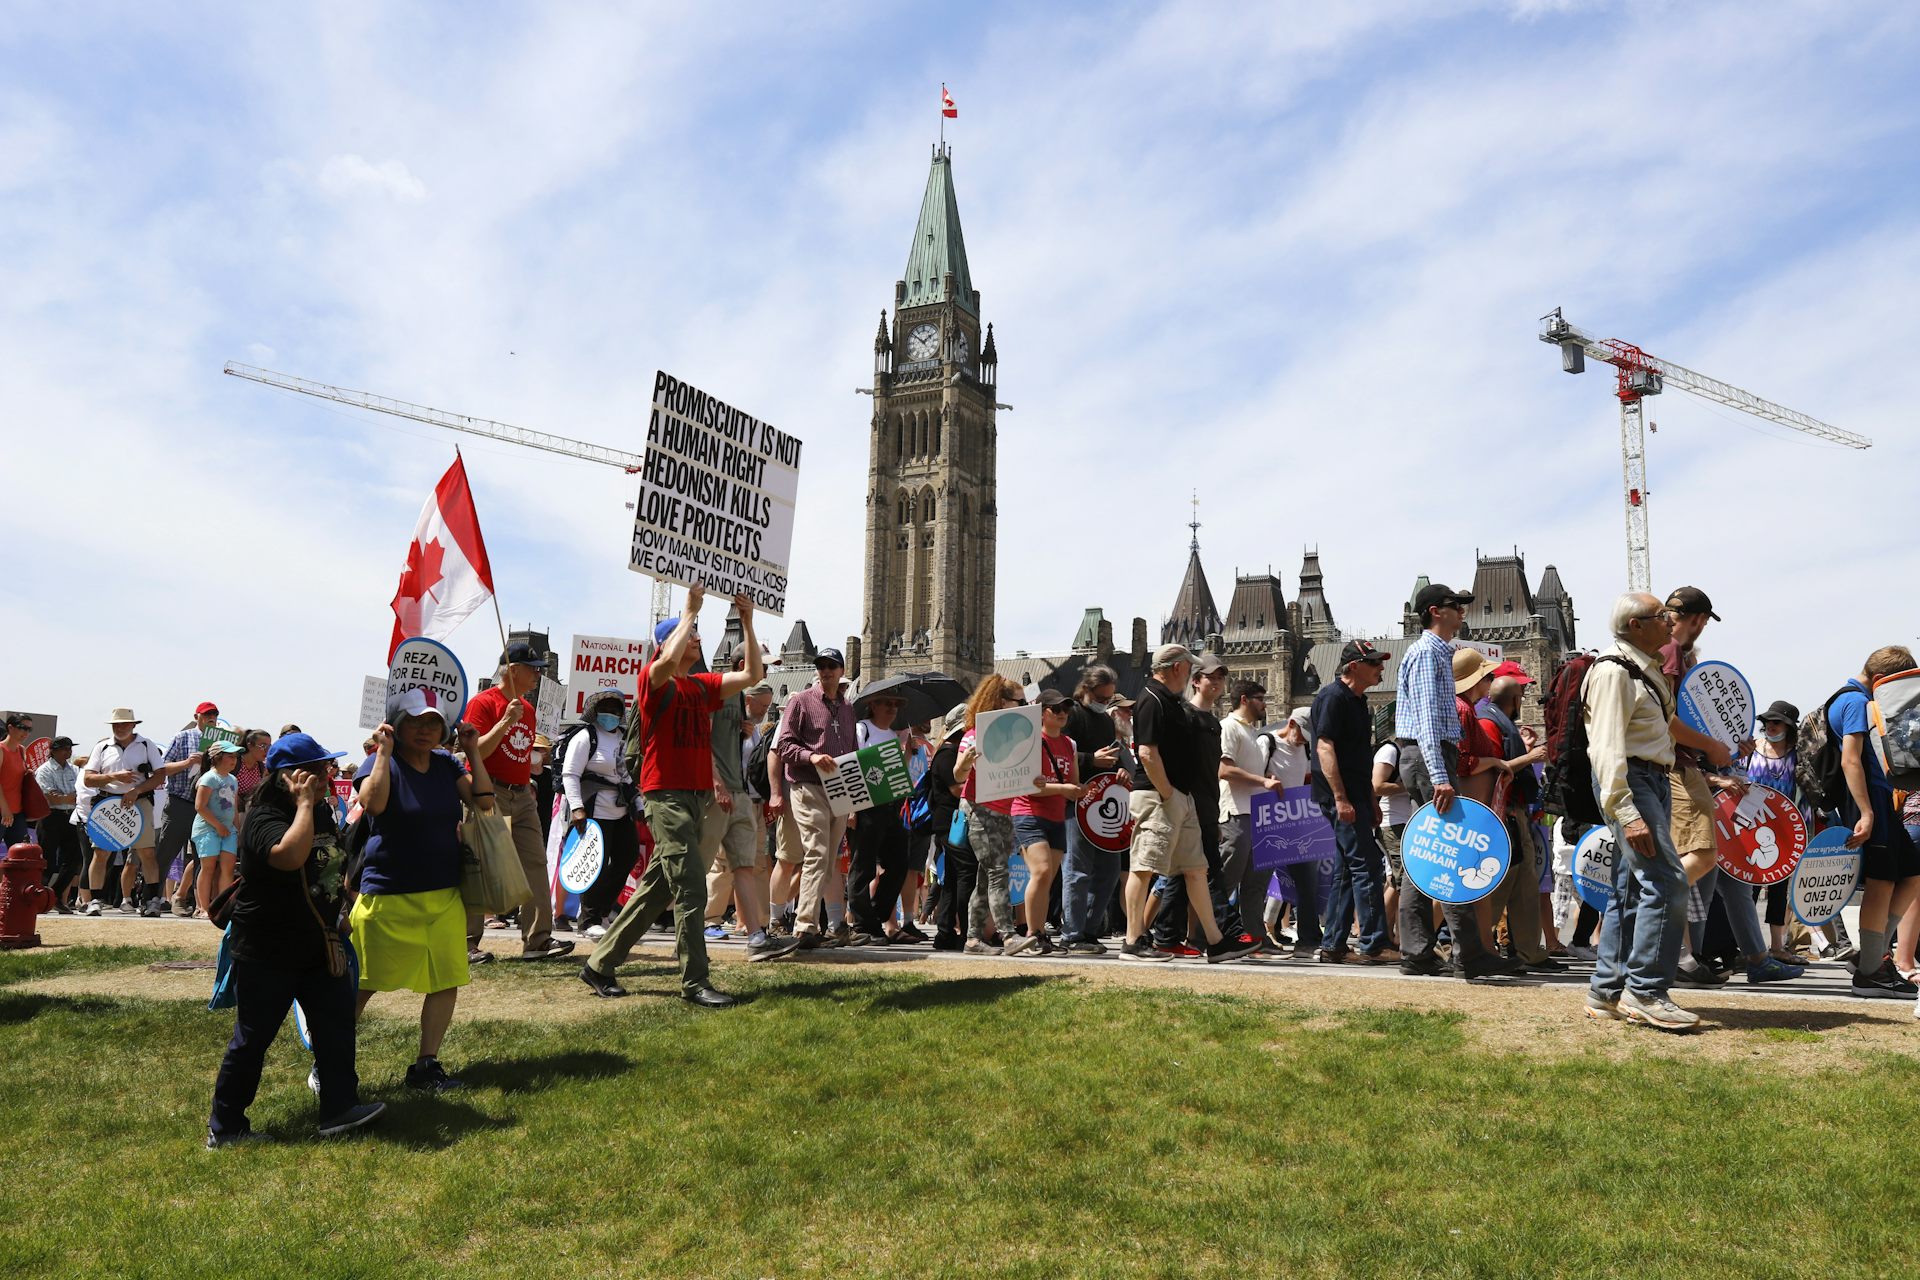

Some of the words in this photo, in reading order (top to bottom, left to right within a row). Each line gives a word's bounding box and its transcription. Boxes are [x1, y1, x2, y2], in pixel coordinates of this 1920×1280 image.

[653, 370, 758, 447] PROMISCUITY
[760, 422, 774, 456] IS
[776, 432, 802, 469] NOT
[647, 409, 658, 444] A
[662, 414, 720, 470] HUMAN
[722, 443, 766, 488] RIGHT
[642, 447, 728, 512] HEDONISM
[730, 486, 770, 528] KILLS
[636, 486, 682, 532] LOVE
[682, 501, 762, 562] PROTECTS
[633, 524, 667, 550] HOW
[669, 538, 710, 565] MANLY
[712, 552, 722, 571] IS
[724, 554, 734, 573] IT
[734, 559, 746, 578] TO
[746, 565, 762, 585] KILL
[763, 570, 787, 593] KIDS?
[632, 546, 653, 569] WE
[656, 555, 695, 582] CAN'T
[698, 570, 741, 596] HANDLE
[744, 584, 755, 603] THE
[756, 589, 785, 612] CHOICE
[581, 640, 623, 652] NATIONAL
[404, 652, 438, 666] REZA
[576, 654, 642, 675] MARCH
[393, 667, 407, 680] POR
[411, 668, 427, 680] EL
[432, 671, 457, 686] FIN
[598, 679, 618, 687] FOR
[1699, 671, 1714, 696] DEL
[1712, 697, 1740, 744] ABORTO
[1711, 671, 1728, 697] POR
[1725, 698, 1736, 714] EL
[1734, 714, 1748, 734] FIN
[1728, 680, 1746, 712] REZA
[203, 727, 223, 741] LOVE
[501, 744, 517, 760] GUARD
[878, 742, 903, 772] LOVE
[840, 760, 870, 805] CHOOSE
[887, 772, 912, 797] LIFE
[988, 767, 1030, 781] WOOMB
[1004, 779, 1022, 789] LIFE
[824, 776, 846, 800] LIFE
[99, 808, 135, 838] ABORTION
[111, 804, 121, 814] TO
[120, 813, 136, 827] END
[1256, 804, 1271, 827] JE
[1274, 798, 1323, 823] SUIS
[1417, 816, 1441, 835] JE
[1442, 823, 1490, 852] SUIS
[1716, 820, 1731, 840] I
[1762, 801, 1804, 882] WONDERFULLY
[567, 834, 598, 881] ABORTION
[590, 849, 599, 863] TO
[1413, 834, 1431, 848] UN
[1431, 838, 1459, 857] ÊTRE
[1409, 846, 1457, 870] HUMAIN
[1717, 854, 1753, 880] MADE
[576, 864, 590, 882] END
[583, 862, 599, 886] PRAY
[1799, 873, 1854, 888] ABORTION
[1804, 890, 1827, 902] END
[1829, 889, 1842, 900] TO
[1806, 904, 1833, 918] PRAY
